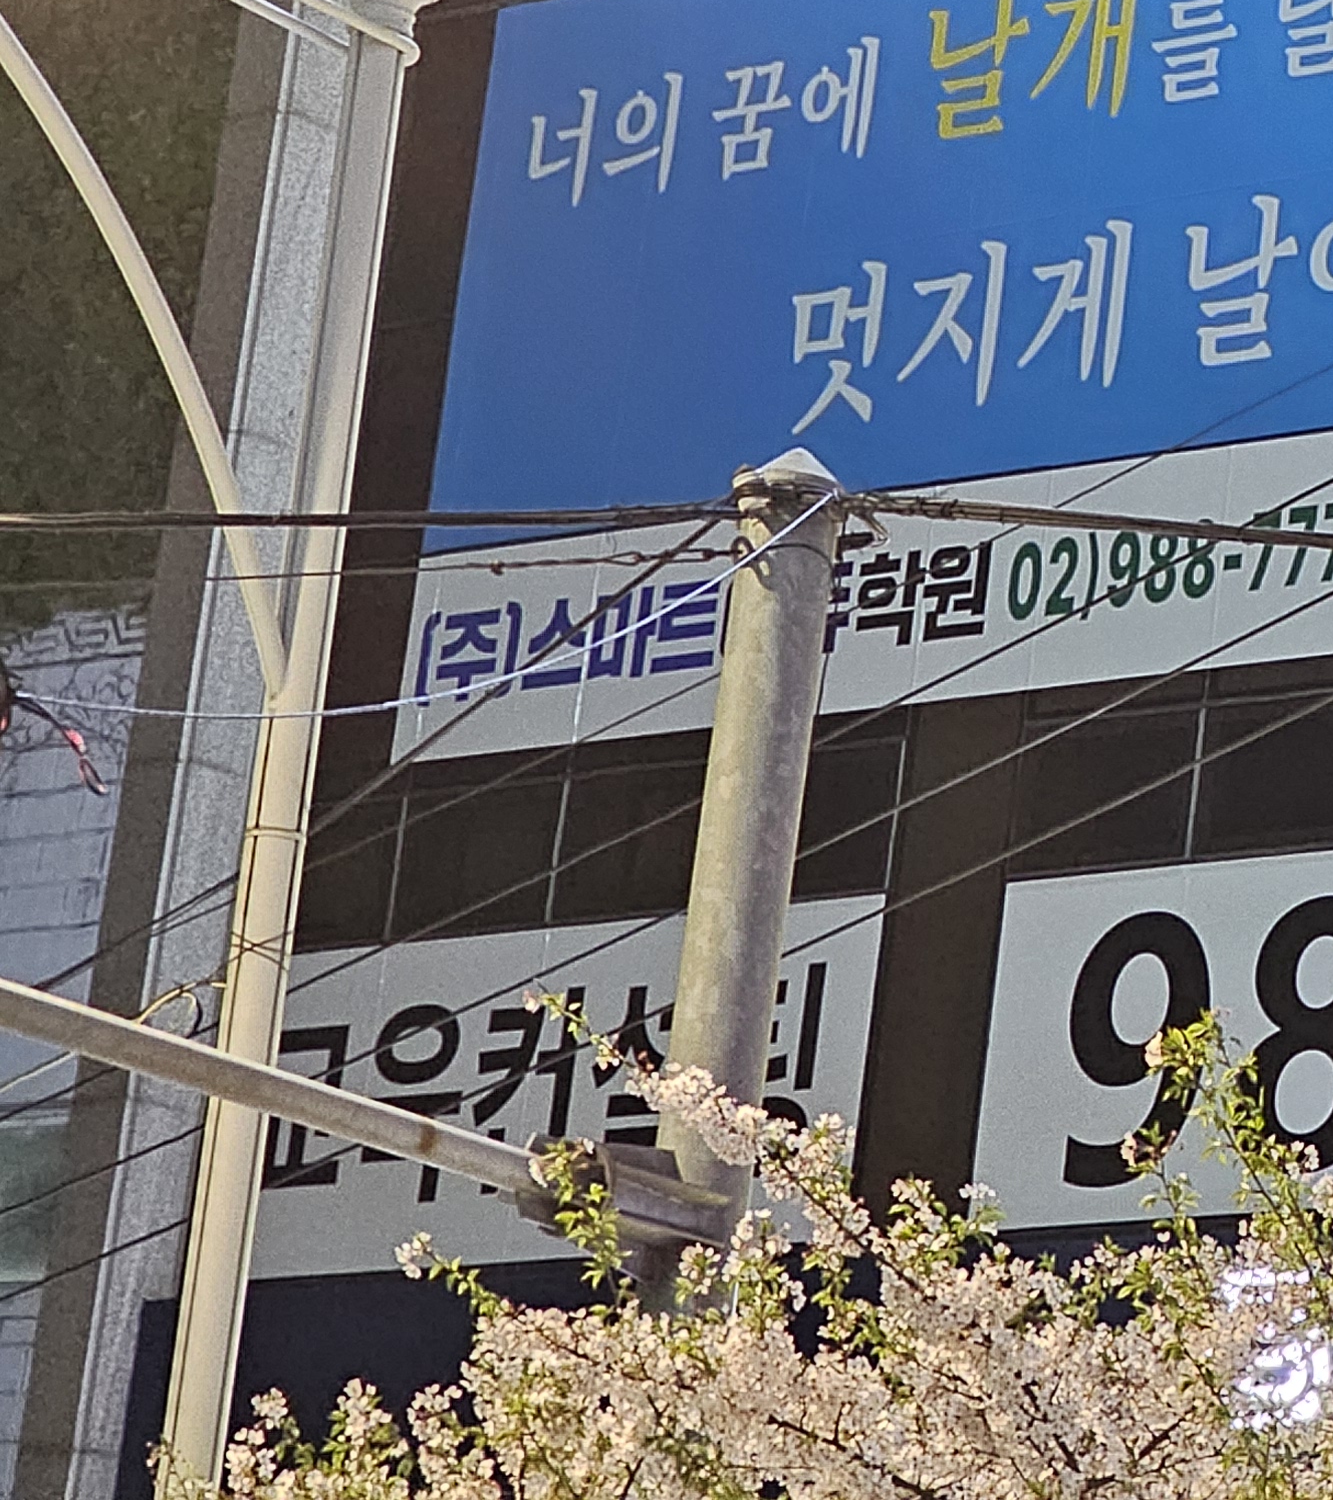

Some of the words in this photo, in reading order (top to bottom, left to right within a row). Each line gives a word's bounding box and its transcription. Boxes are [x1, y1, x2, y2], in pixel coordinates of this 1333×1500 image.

[528, 71, 684, 207] 너의
[710, 35, 881, 181] 꿈에
[791, 218, 1133, 436] 멋지게
[413, 540, 992, 708] (주)스마트학원
